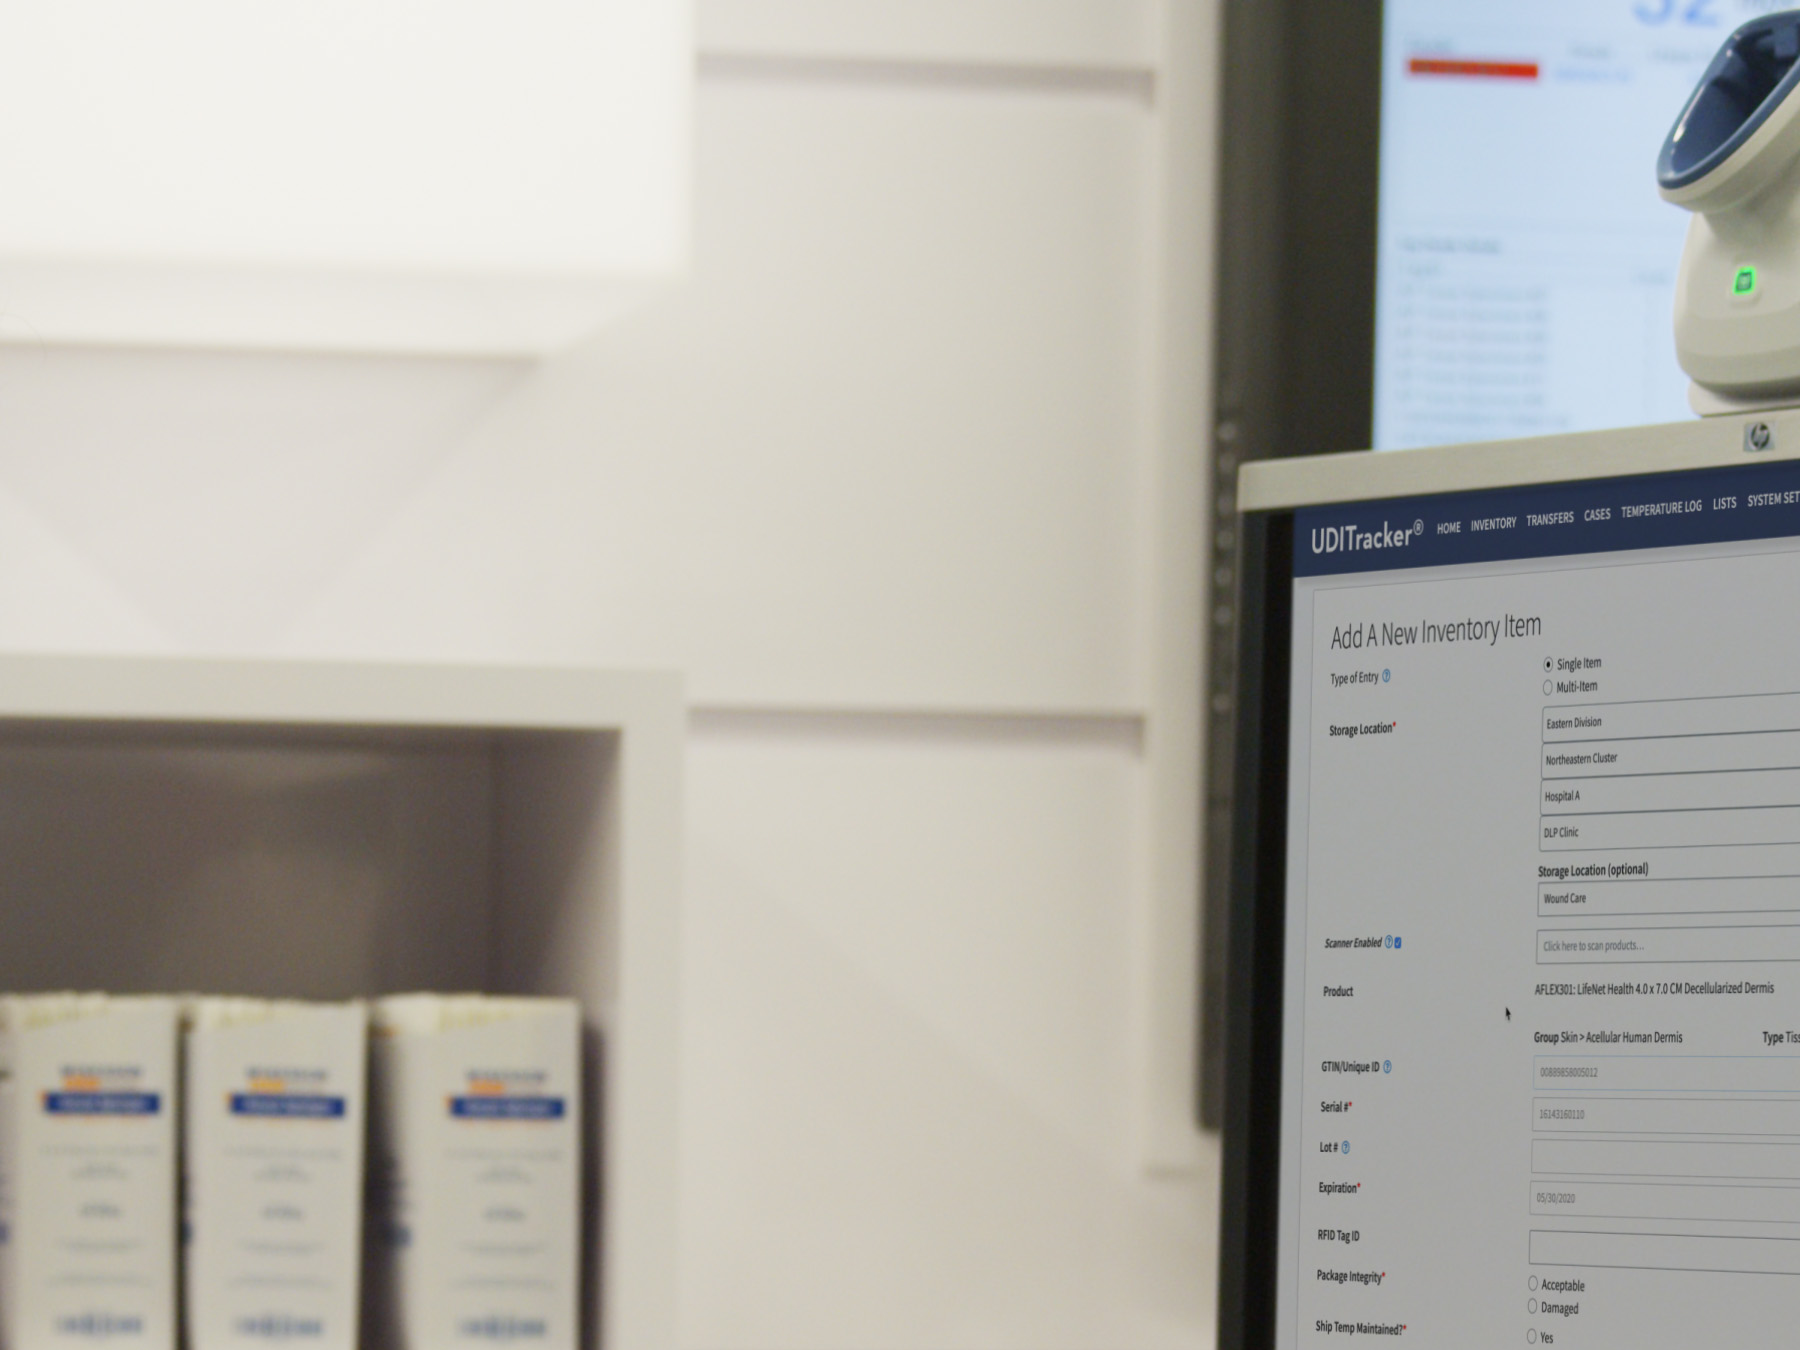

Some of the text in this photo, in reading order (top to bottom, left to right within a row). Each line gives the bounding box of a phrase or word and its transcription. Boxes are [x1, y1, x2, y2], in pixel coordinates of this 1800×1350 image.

[1437, 521, 1461, 535] HOME
[1471, 516, 1517, 532] INVENTORY
[1526, 511, 1574, 527] TRANSFERS
[1584, 508, 1611, 522] CASES
[1621, 501, 1683, 518] TEMPERATURE
[1684, 499, 1702, 513] LOG
[1713, 496, 1737, 511] LISTS
[1747, 492, 1782, 507] SYSTEM
[1330, 613, 1541, 650] Add A New Inventory Item
[1557, 656, 1602, 673] Single Item
[1330, 670, 1379, 688] Type of Entry
[1556, 680, 1598, 694] Multi-Item
[1329, 724, 1358, 738] Storage
[1546, 717, 1602, 730] Eastern Division
[1546, 752, 1618, 766] Northeastern Cluster
[1544, 791, 1580, 804] Hospital A
[1544, 827, 1579, 838] DLP Clinic
[1538, 862, 1649, 880] Storage Location (optional)
[1544, 893, 1586, 904] Wound Care
[1324, 937, 1383, 949] Scanner Enabled
[1543, 940, 1561, 952] Click
[1561, 940, 1578, 951] here
[1578, 941, 1586, 951] to
[1587, 943, 1604, 951] scan
[1323, 985, 1354, 997] Product
[1534, 983, 1576, 996] AFLEX301:
[1577, 983, 1606, 995] LifeNet
[1607, 983, 1634, 995] Health
[1635, 983, 1648, 995] 4.0
[1656, 983, 1668, 995] 7.0
[1669, 983, 1683, 994] CM
[1684, 981, 1743, 995] Decellularized
[1744, 981, 1775, 994] Dermis
[1534, 1032, 1559, 1046] Group
[1560, 1031, 1579, 1043] Skin
[1586, 1031, 1621, 1043] Acellular
[1622, 1031, 1653, 1043] Human
[1654, 1031, 1683, 1043] Dermis
[1762, 1031, 1784, 1046] Type
[1321, 1060, 1380, 1075] GTIN/Unique ID
[1320, 1101, 1343, 1113] Serial
[1319, 1142, 1332, 1153] Lot
[1317, 1229, 1360, 1245] RFID Tag ID
[1316, 1270, 1348, 1285] Package
[1541, 1278, 1585, 1293] Acceptable
[1541, 1301, 1579, 1317] Damaged
[1315, 1320, 1333, 1334] Ship
[1334, 1321, 1355, 1336] Temp
[1540, 1331, 1554, 1344] Yes
